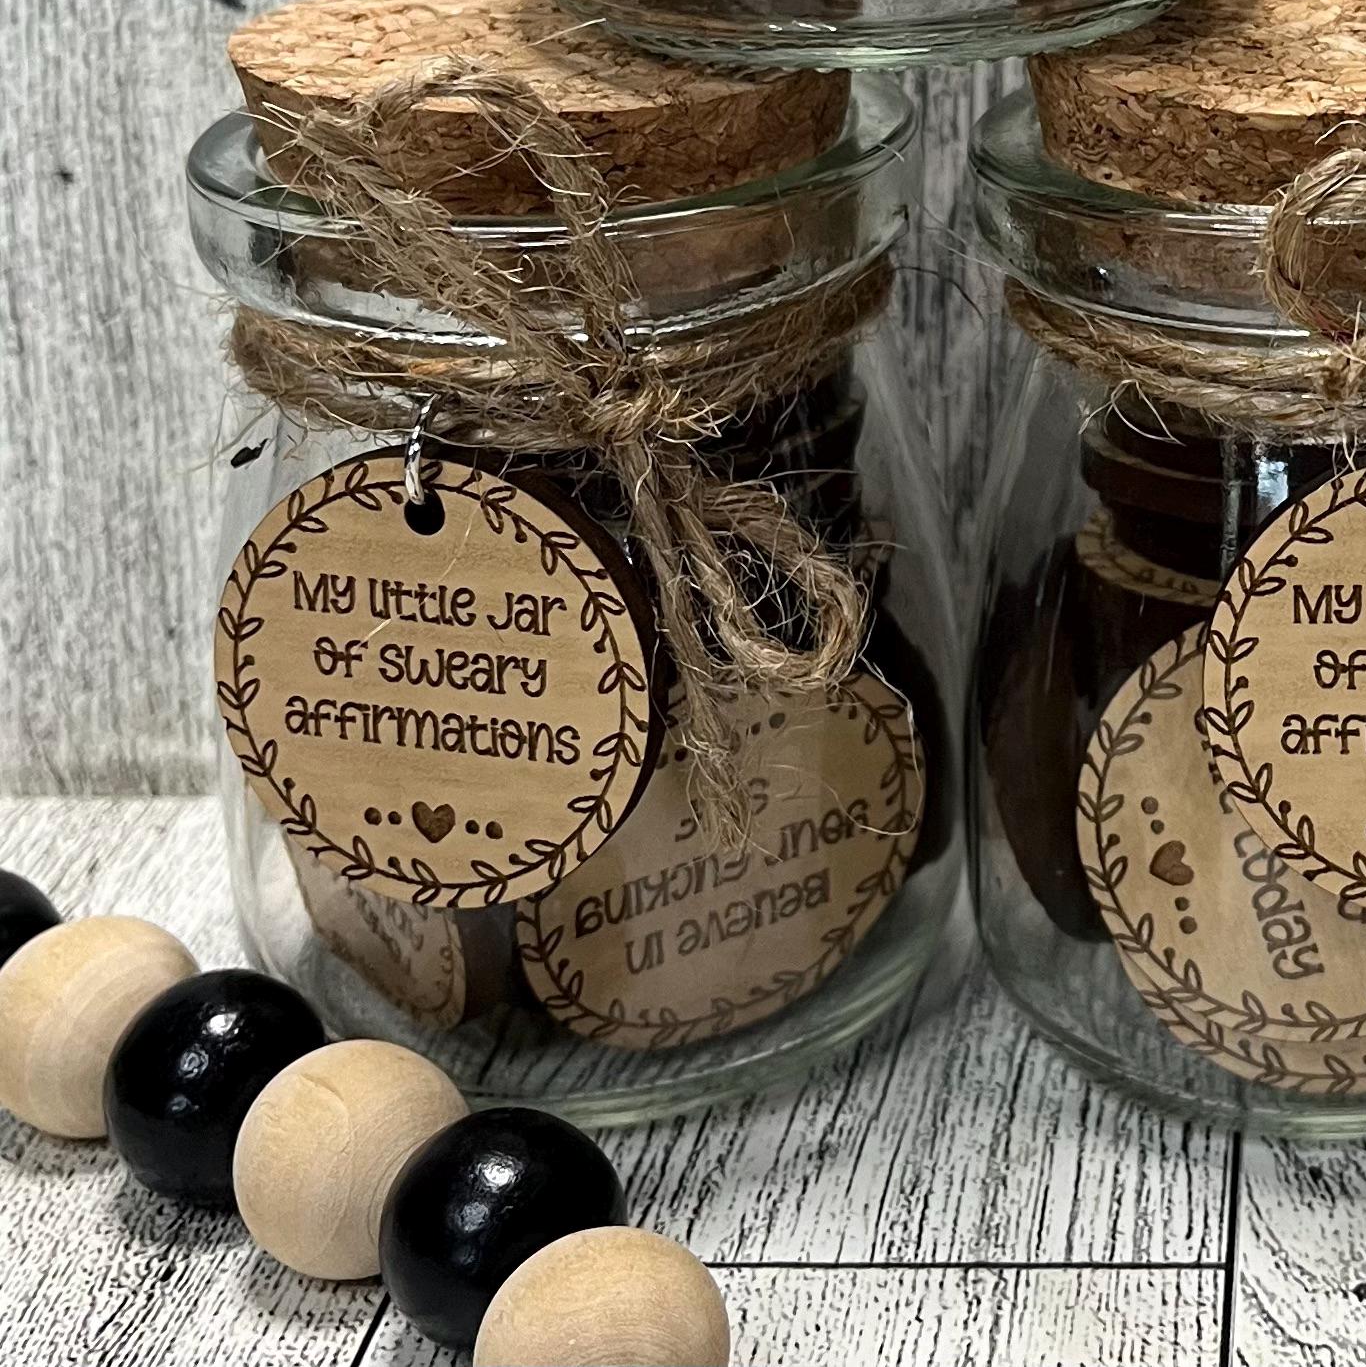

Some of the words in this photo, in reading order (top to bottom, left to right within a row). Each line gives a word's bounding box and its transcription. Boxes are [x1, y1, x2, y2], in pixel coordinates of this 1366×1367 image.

[293, 570, 356, 614] My
[1293, 585, 1362, 624] My
[313, 636, 369, 678] of
[378, 643, 547, 697] sweary
[284, 695, 581, 765] affirmations
